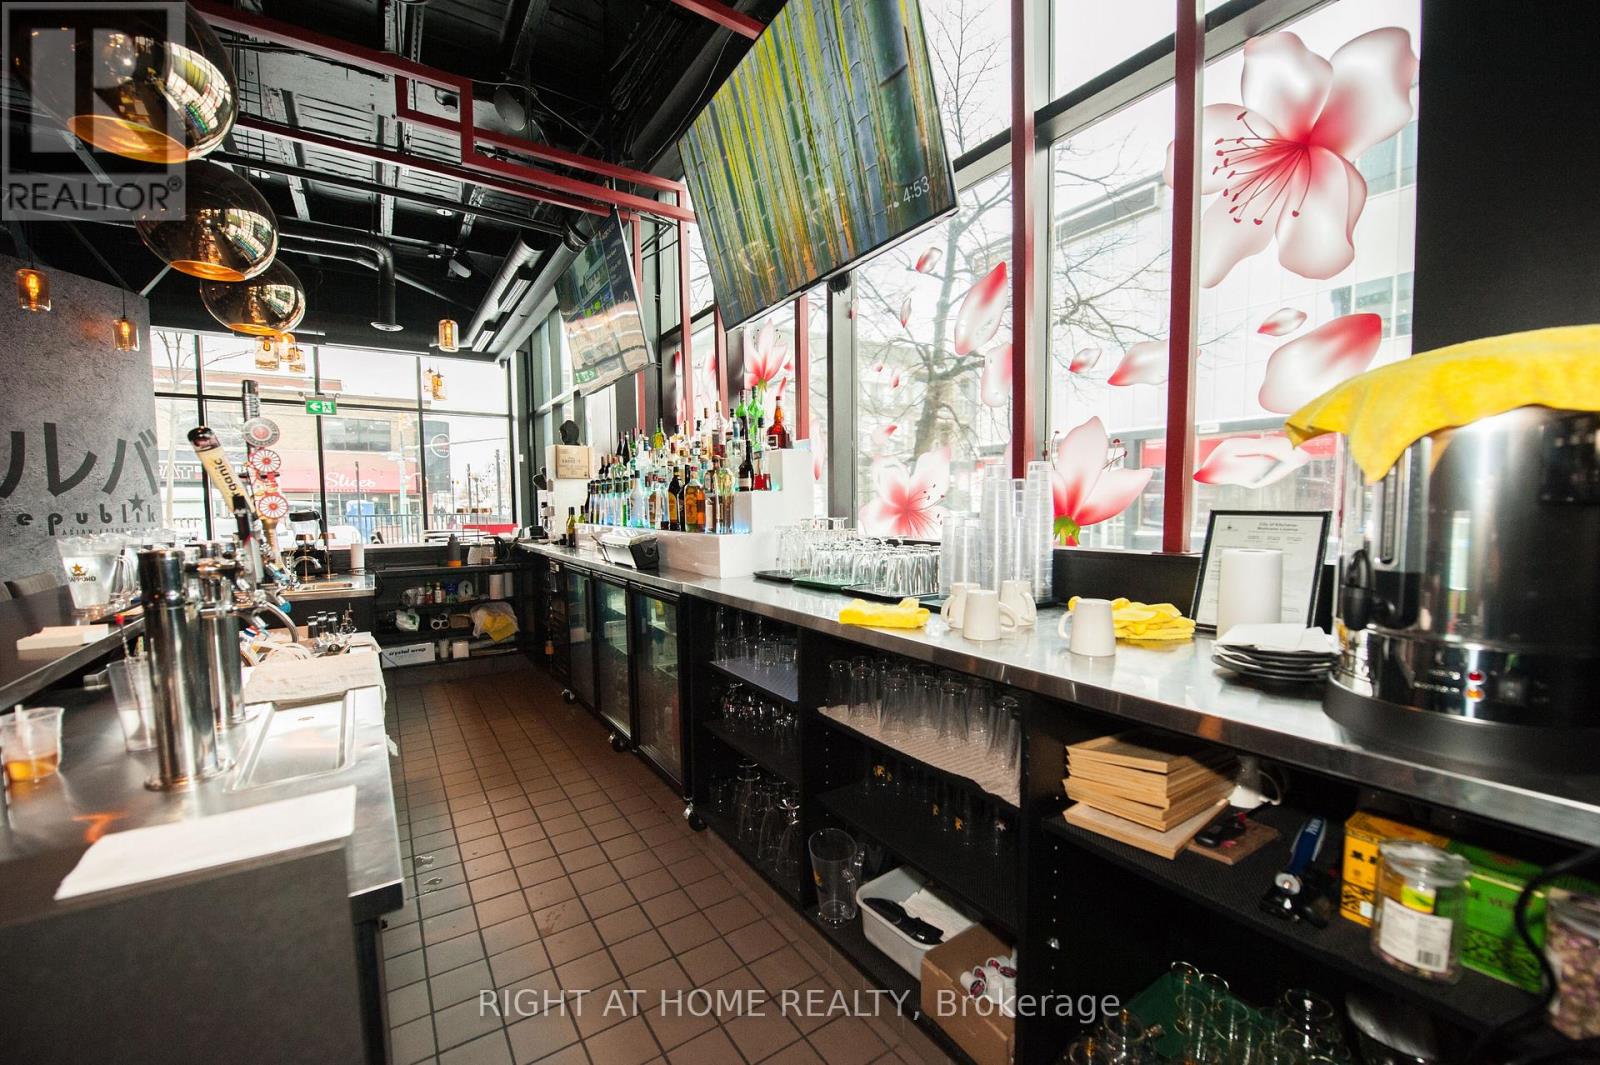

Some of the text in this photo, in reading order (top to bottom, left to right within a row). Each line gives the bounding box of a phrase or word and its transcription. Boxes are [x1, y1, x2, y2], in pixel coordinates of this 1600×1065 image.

[903, 175, 930, 203] 4:53
[214, 458, 240, 497] rganic
[0, 493, 156, 536] epublik
[62, 527, 93, 537] ASIAN
